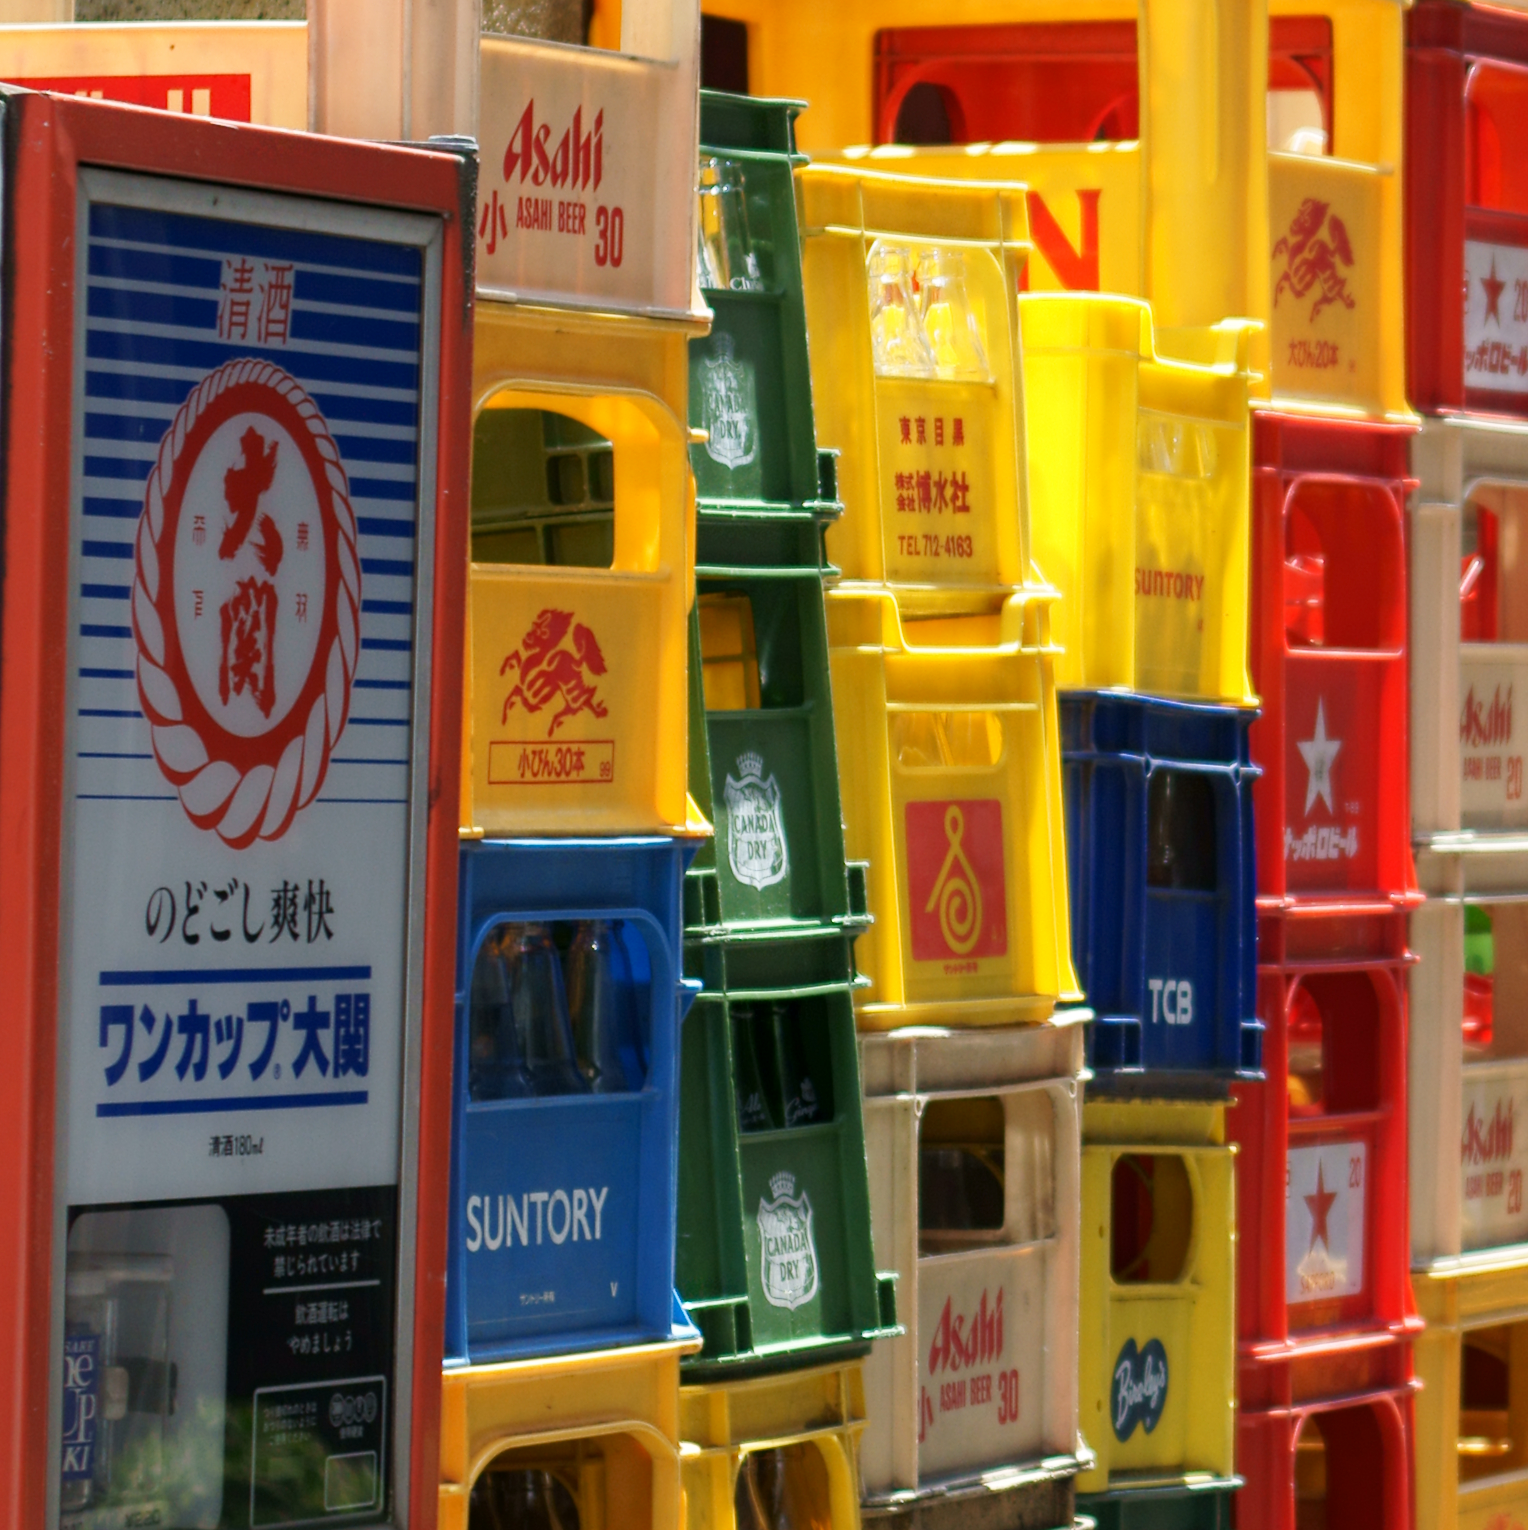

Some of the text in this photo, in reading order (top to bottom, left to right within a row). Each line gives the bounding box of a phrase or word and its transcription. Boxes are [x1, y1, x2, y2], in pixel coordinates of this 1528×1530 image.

[502, 97, 604, 193] Asahi
[479, 190, 623, 267] 小 ASAHI BEER 30
[215, 257, 295, 346] 清酒
[1514, 279, 1528, 323] 20
[1464, 341, 1528, 375] ッポロビール
[899, 417, 965, 447] 東京目黒
[898, 533, 973, 558] TEL 712-4163
[1460, 683, 1512, 748] Asahi
[518, 747, 585, 779] 小びん30本
[1506, 755, 1523, 800] 20
[734, 814, 776, 835] CANADA
[747, 840, 768, 861] DRY
[145, 877, 334, 946] のどごし爽快
[1148, 979, 1193, 1024] TCB
[1461, 1096, 1513, 1167] Asahi
[1349, 1157, 1361, 1188] 20
[1507, 1170, 1523, 1214] 20
[466, 1186, 608, 1252] SUNTORY
[766, 1235, 807, 1256] CANADA
[779, 1261, 800, 1283] DRY
[287, 1330, 351, 1355] やめましょう
[928, 1287, 1004, 1376] Asahi
[939, 1381, 966, 1413] ASAHI
[970, 1374, 992, 1407] BEER
[998, 1370, 1019, 1425] 30
